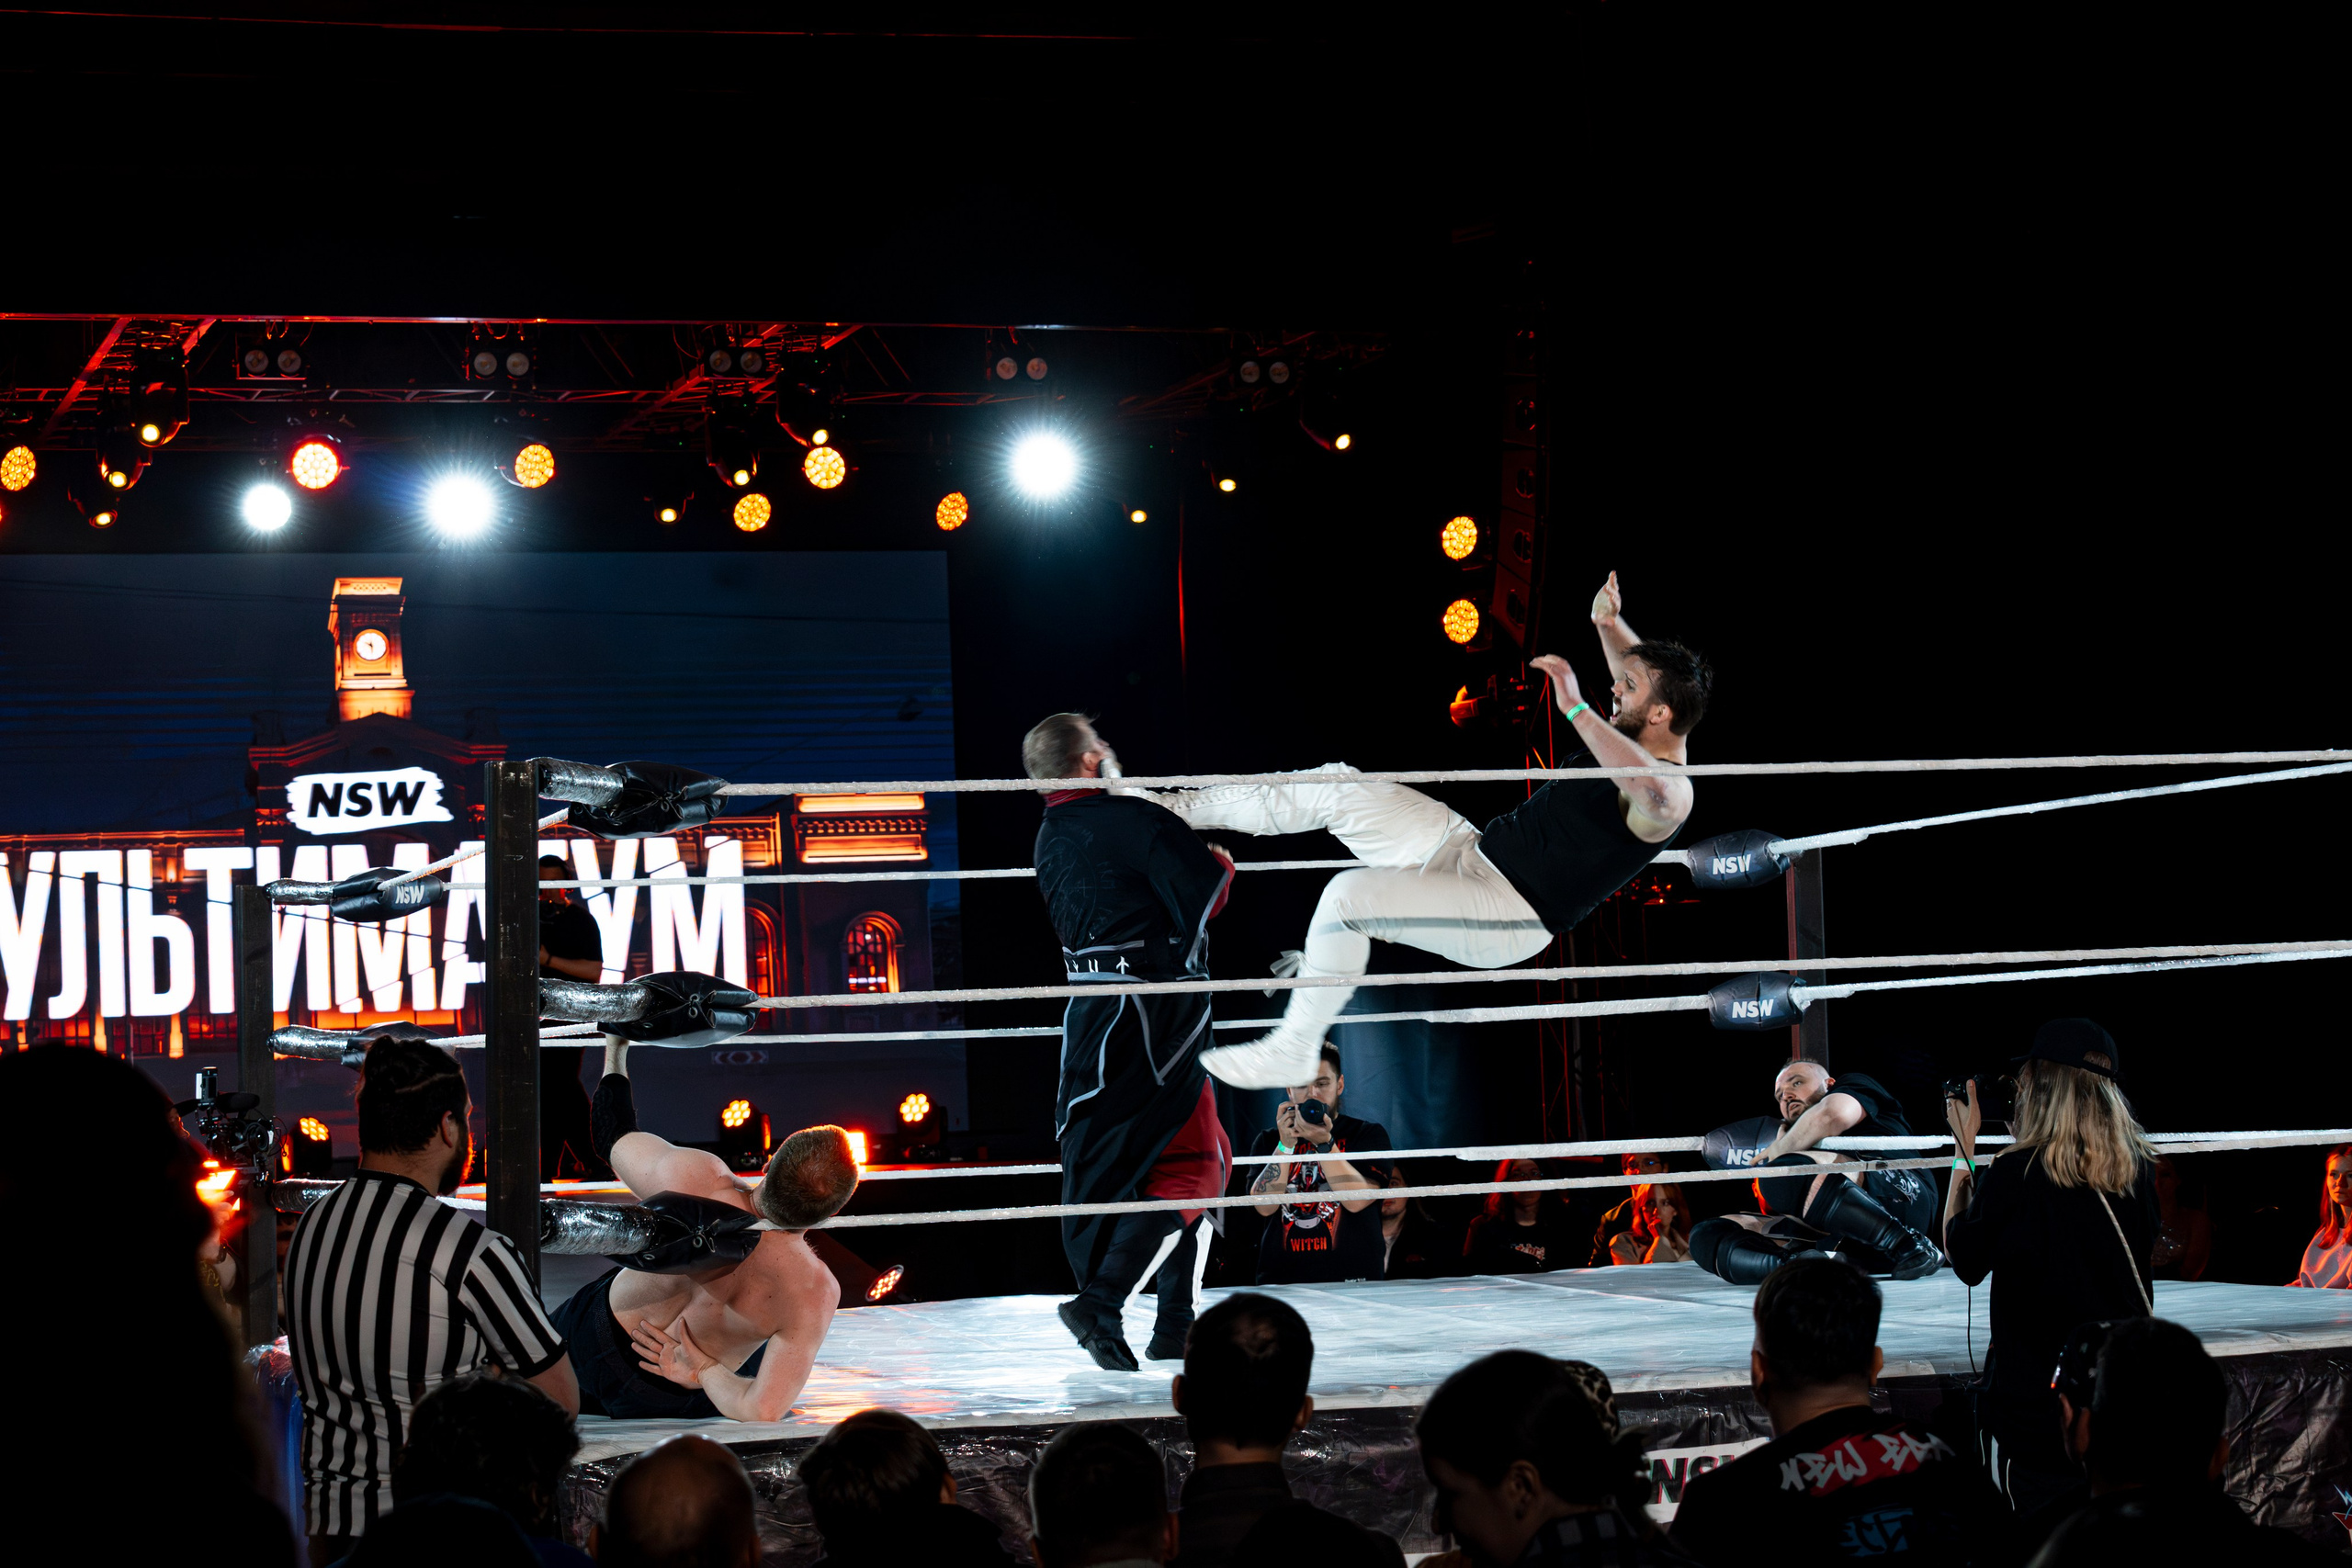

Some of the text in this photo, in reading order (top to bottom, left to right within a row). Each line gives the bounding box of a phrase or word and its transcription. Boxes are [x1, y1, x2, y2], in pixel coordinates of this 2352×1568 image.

[307, 781, 426, 818] NSW
[1713, 853, 1752, 875] NSW
[395, 885, 424, 904] NSW
[0, 835, 747, 1021] УЛЬТИМАУМ
[1732, 998, 1774, 1019] NSW
[1290, 1235, 1328, 1252] WITCH
